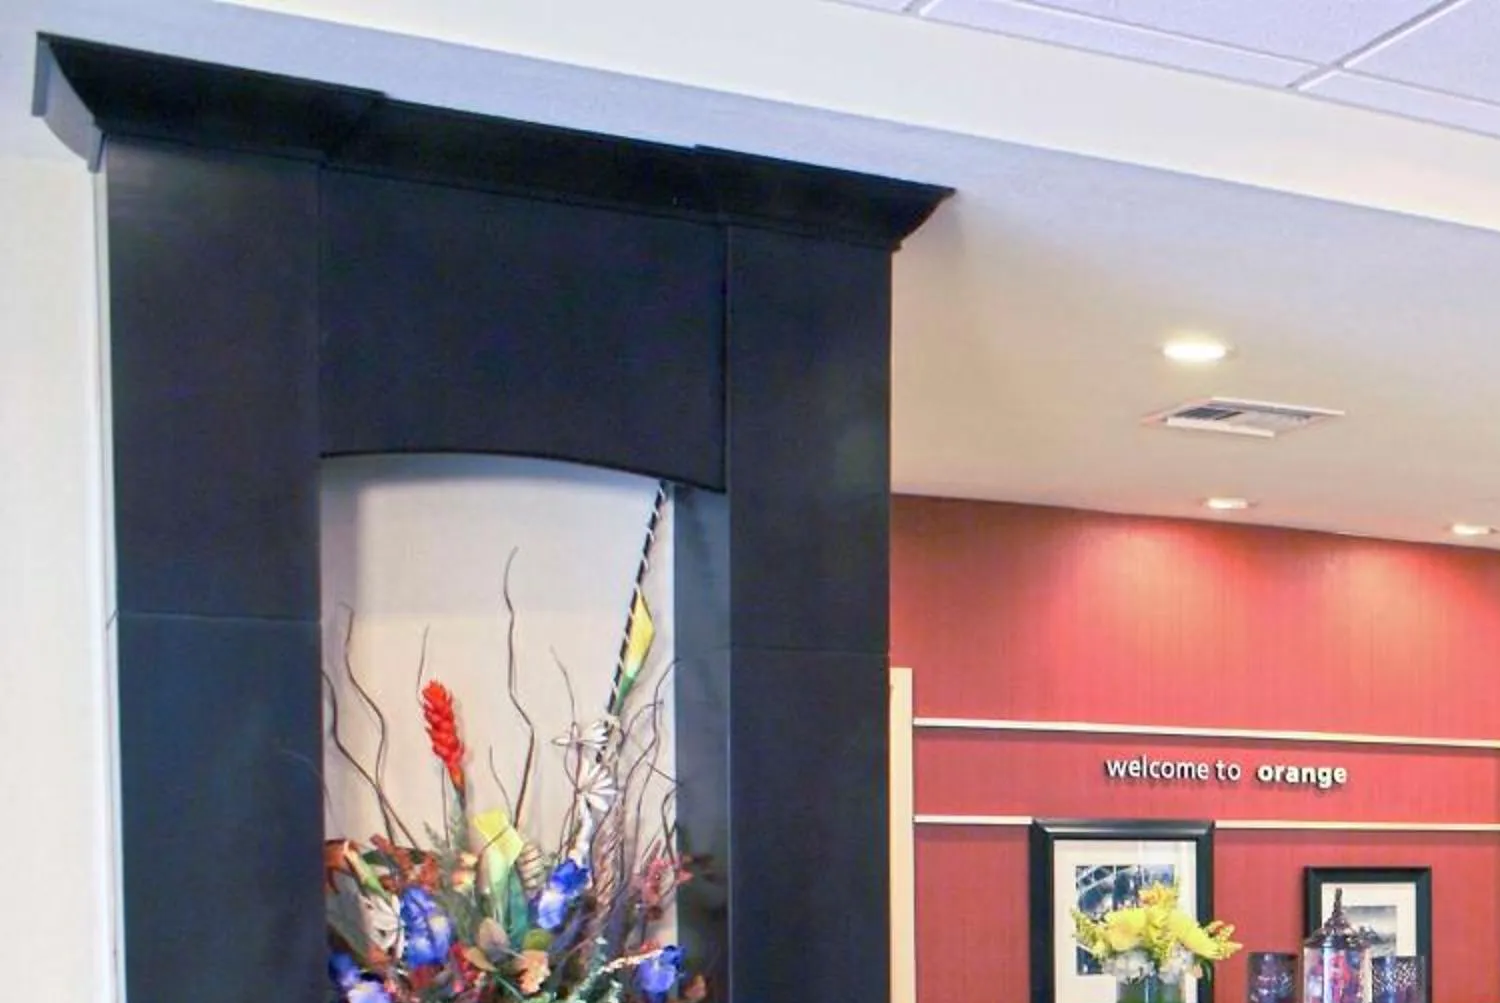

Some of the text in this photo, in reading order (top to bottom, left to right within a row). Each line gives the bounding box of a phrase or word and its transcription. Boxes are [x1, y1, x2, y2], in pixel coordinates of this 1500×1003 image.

[1106, 754, 1348, 788] welcome to orange
